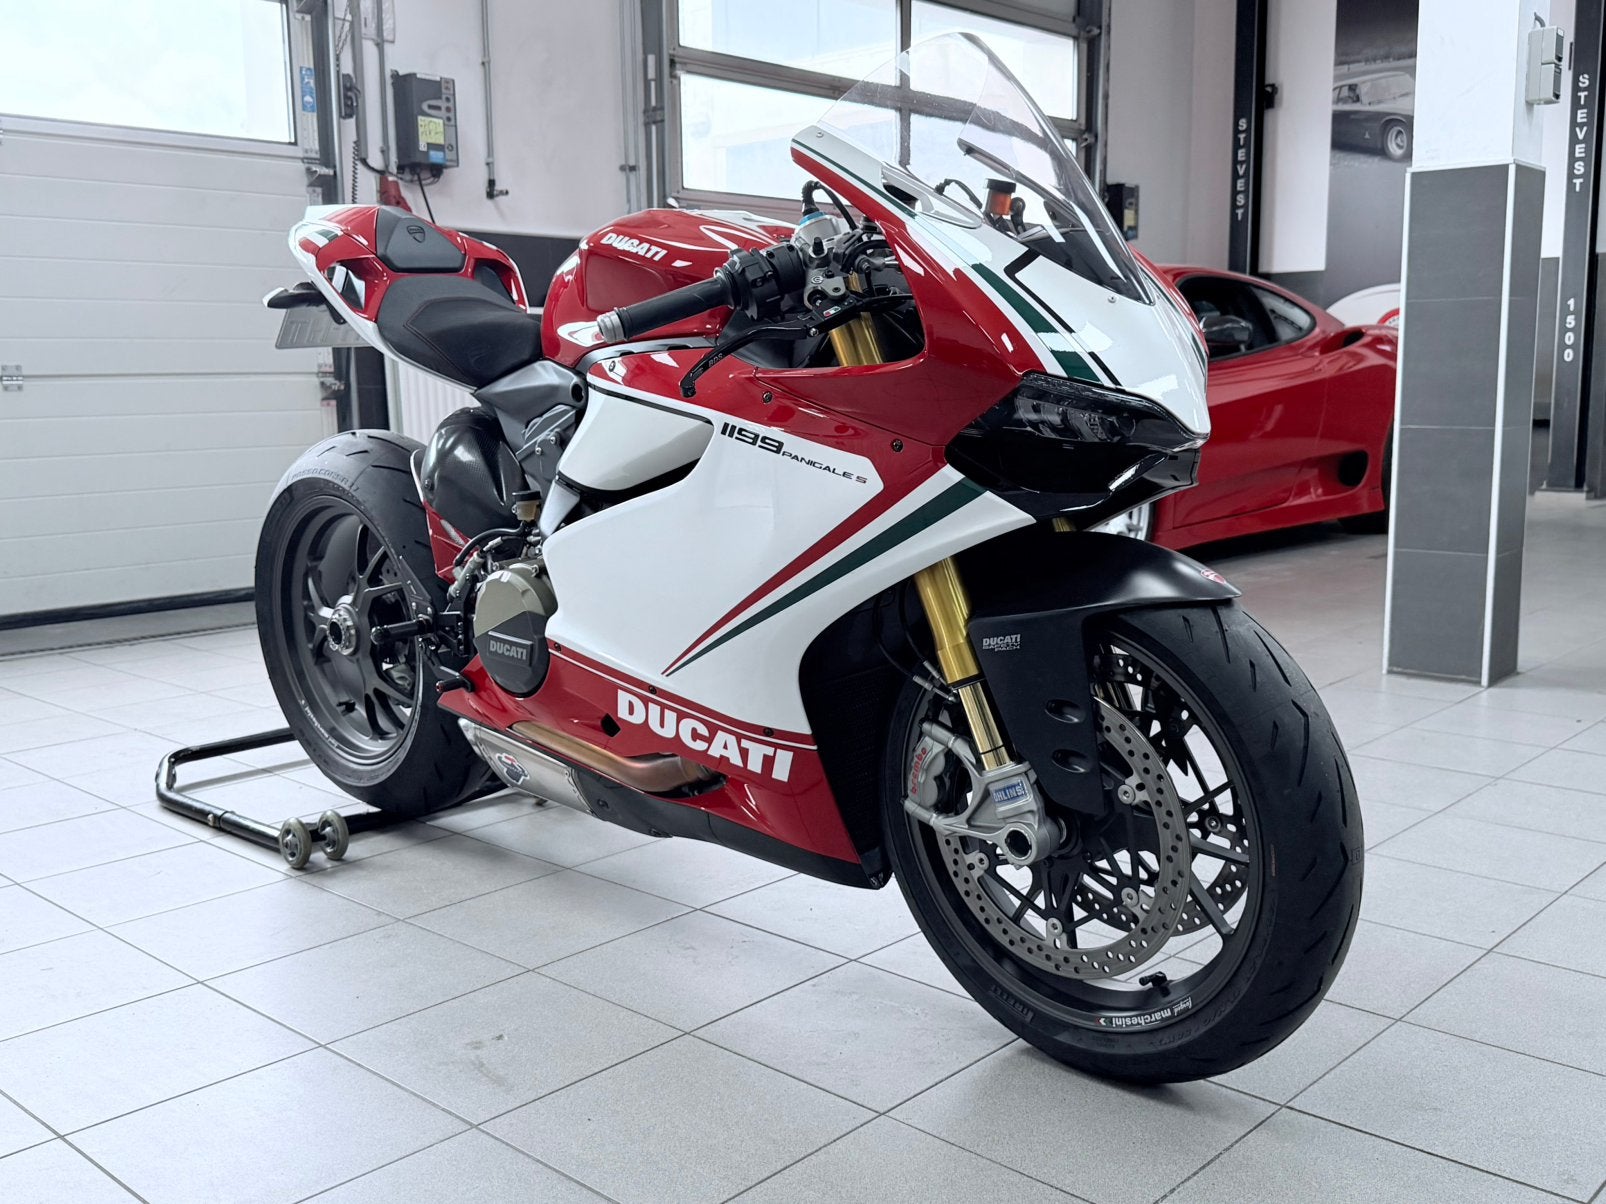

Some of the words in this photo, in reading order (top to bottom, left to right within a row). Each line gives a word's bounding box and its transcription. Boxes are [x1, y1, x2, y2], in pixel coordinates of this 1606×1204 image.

[1573, 73, 1590, 192] STEVEST
[1236, 118, 1248, 221] STEVEST
[600, 233, 668, 262] DUCATI
[1563, 297, 1576, 362] 1500
[720, 421, 784, 455] 1199
[781, 450, 854, 480] PANIGALE
[855, 475, 868, 484] S
[489, 639, 527, 660] DUCATI
[982, 633, 1021, 646] DUCATI
[617, 688, 794, 783] DUCATI
[911, 747, 927, 796] brembo
[1112, 1007, 1171, 1027] marchesini
